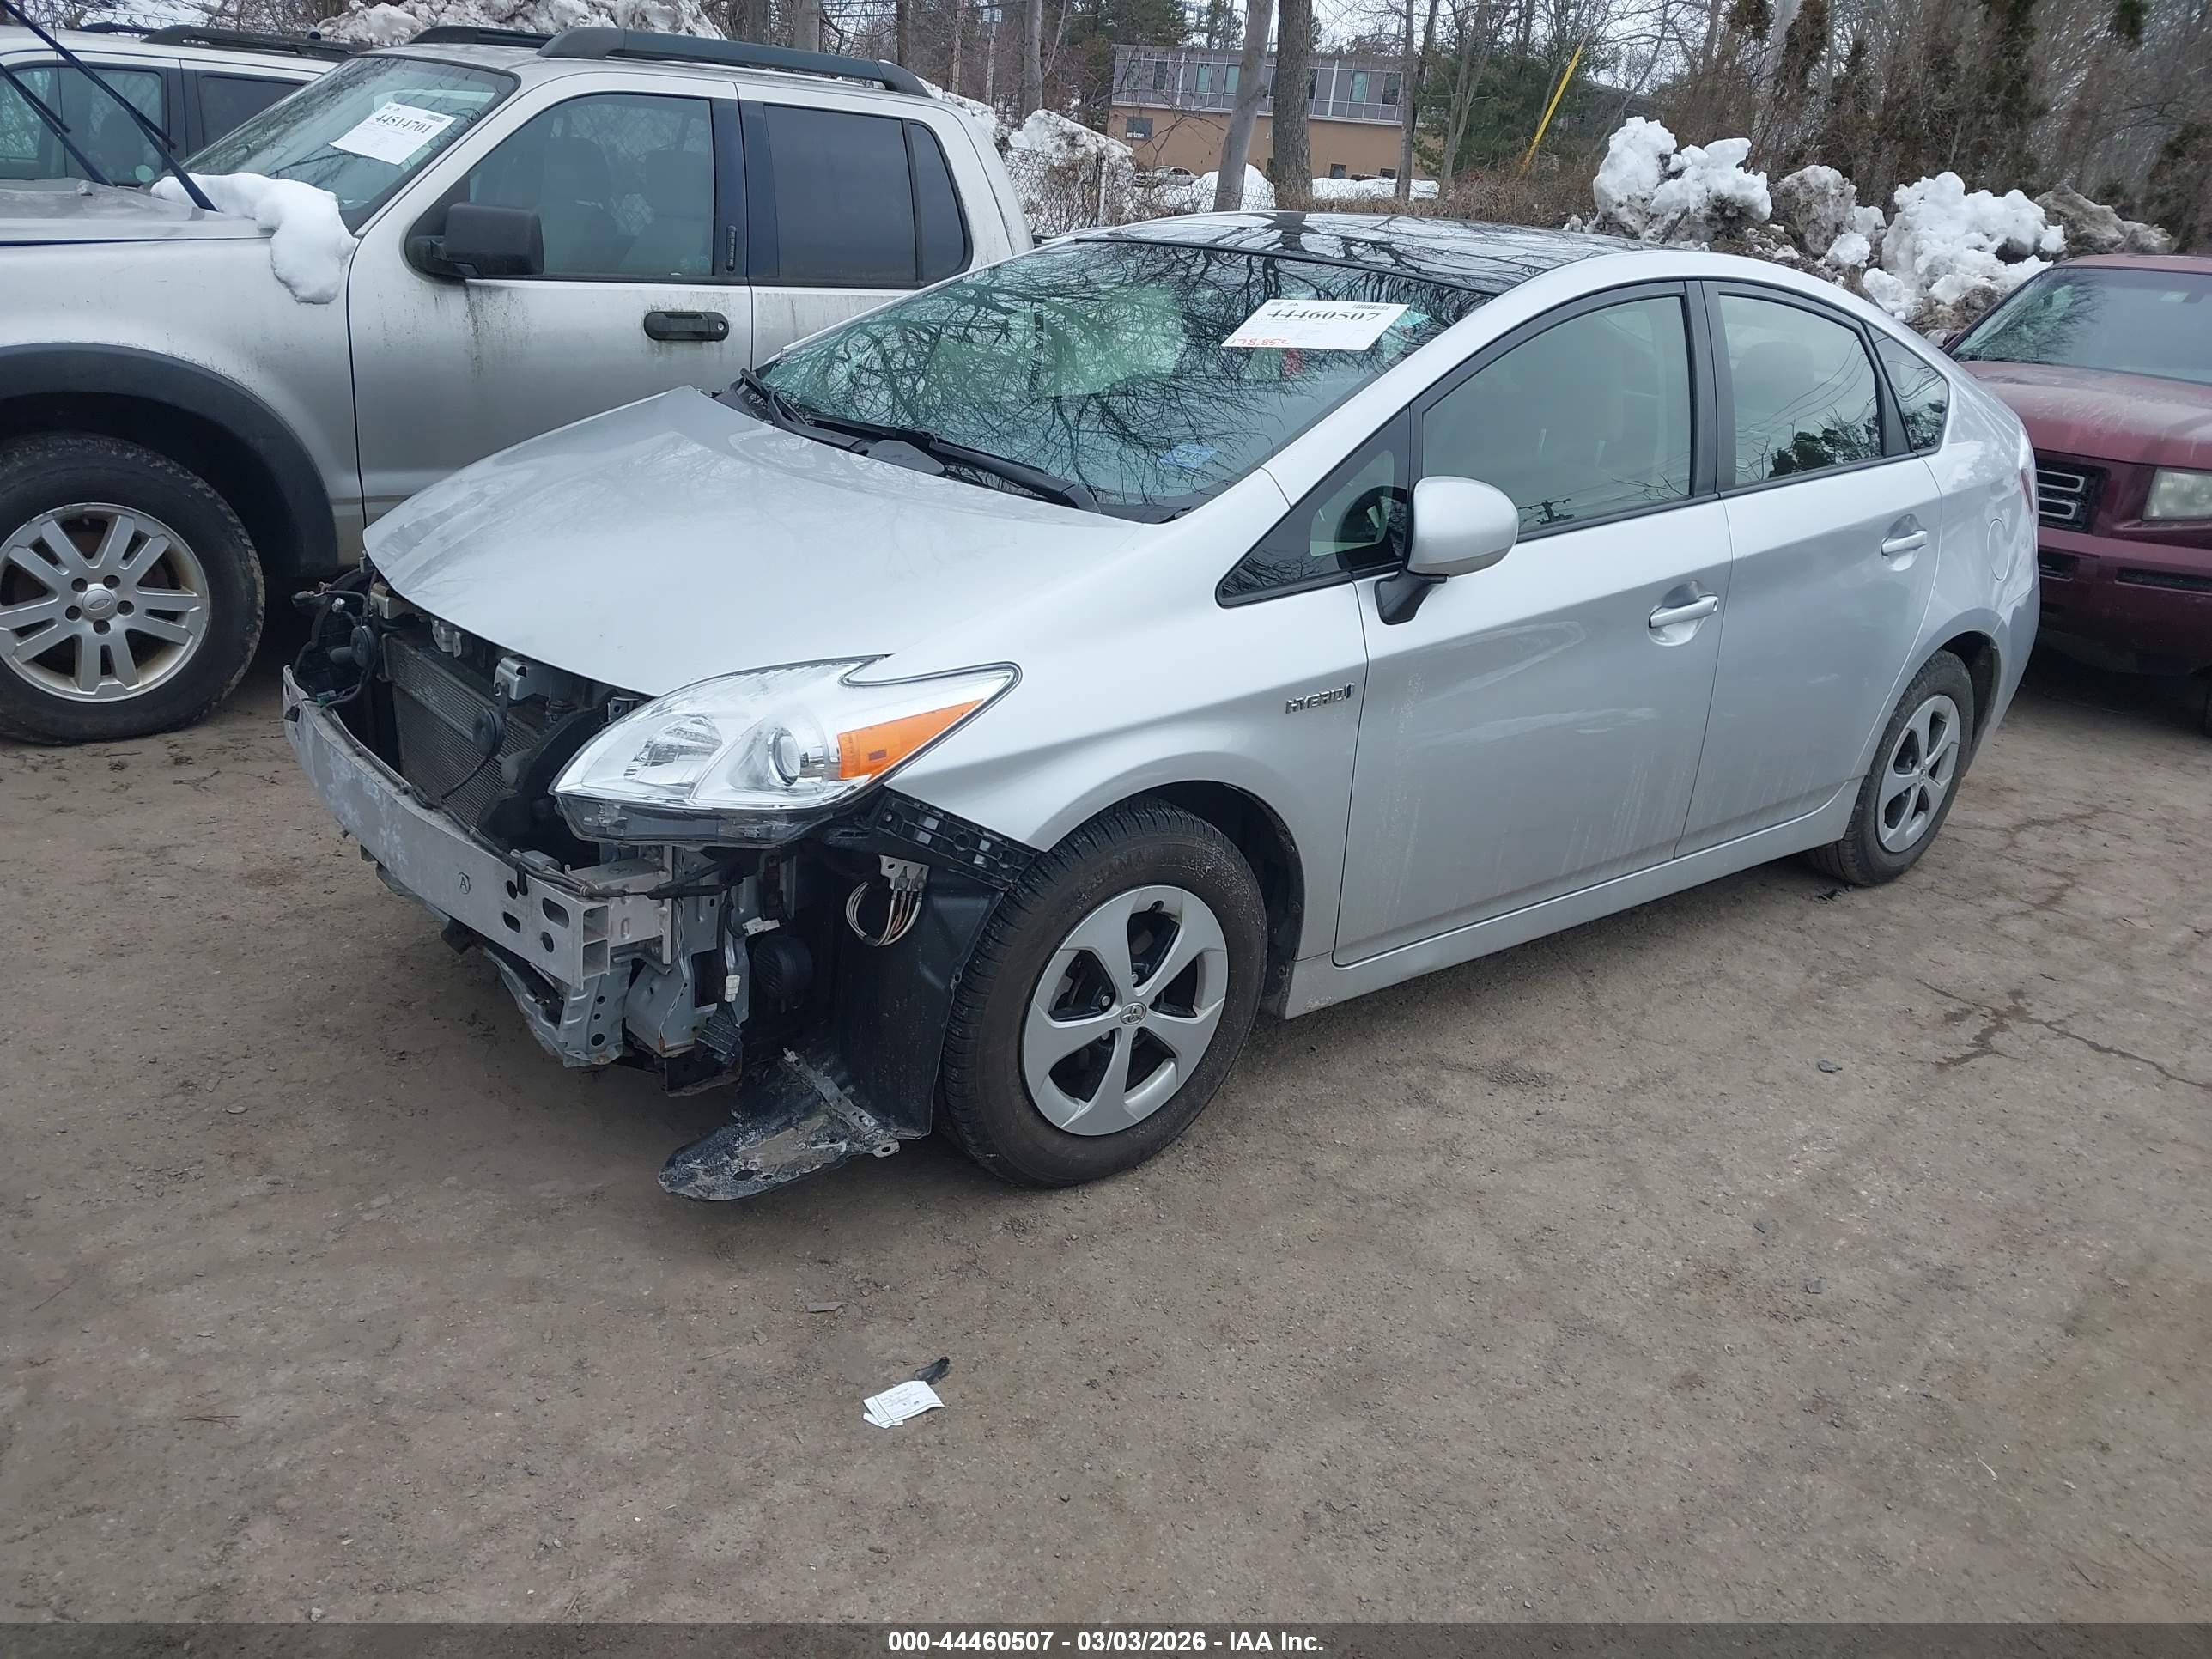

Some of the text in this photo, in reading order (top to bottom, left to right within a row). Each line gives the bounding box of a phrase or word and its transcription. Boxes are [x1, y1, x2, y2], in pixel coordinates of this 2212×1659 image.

[374, 112, 433, 134] 44514701
[1267, 309, 1382, 322] 44460507
[1285, 688, 1346, 714] HYBRID
